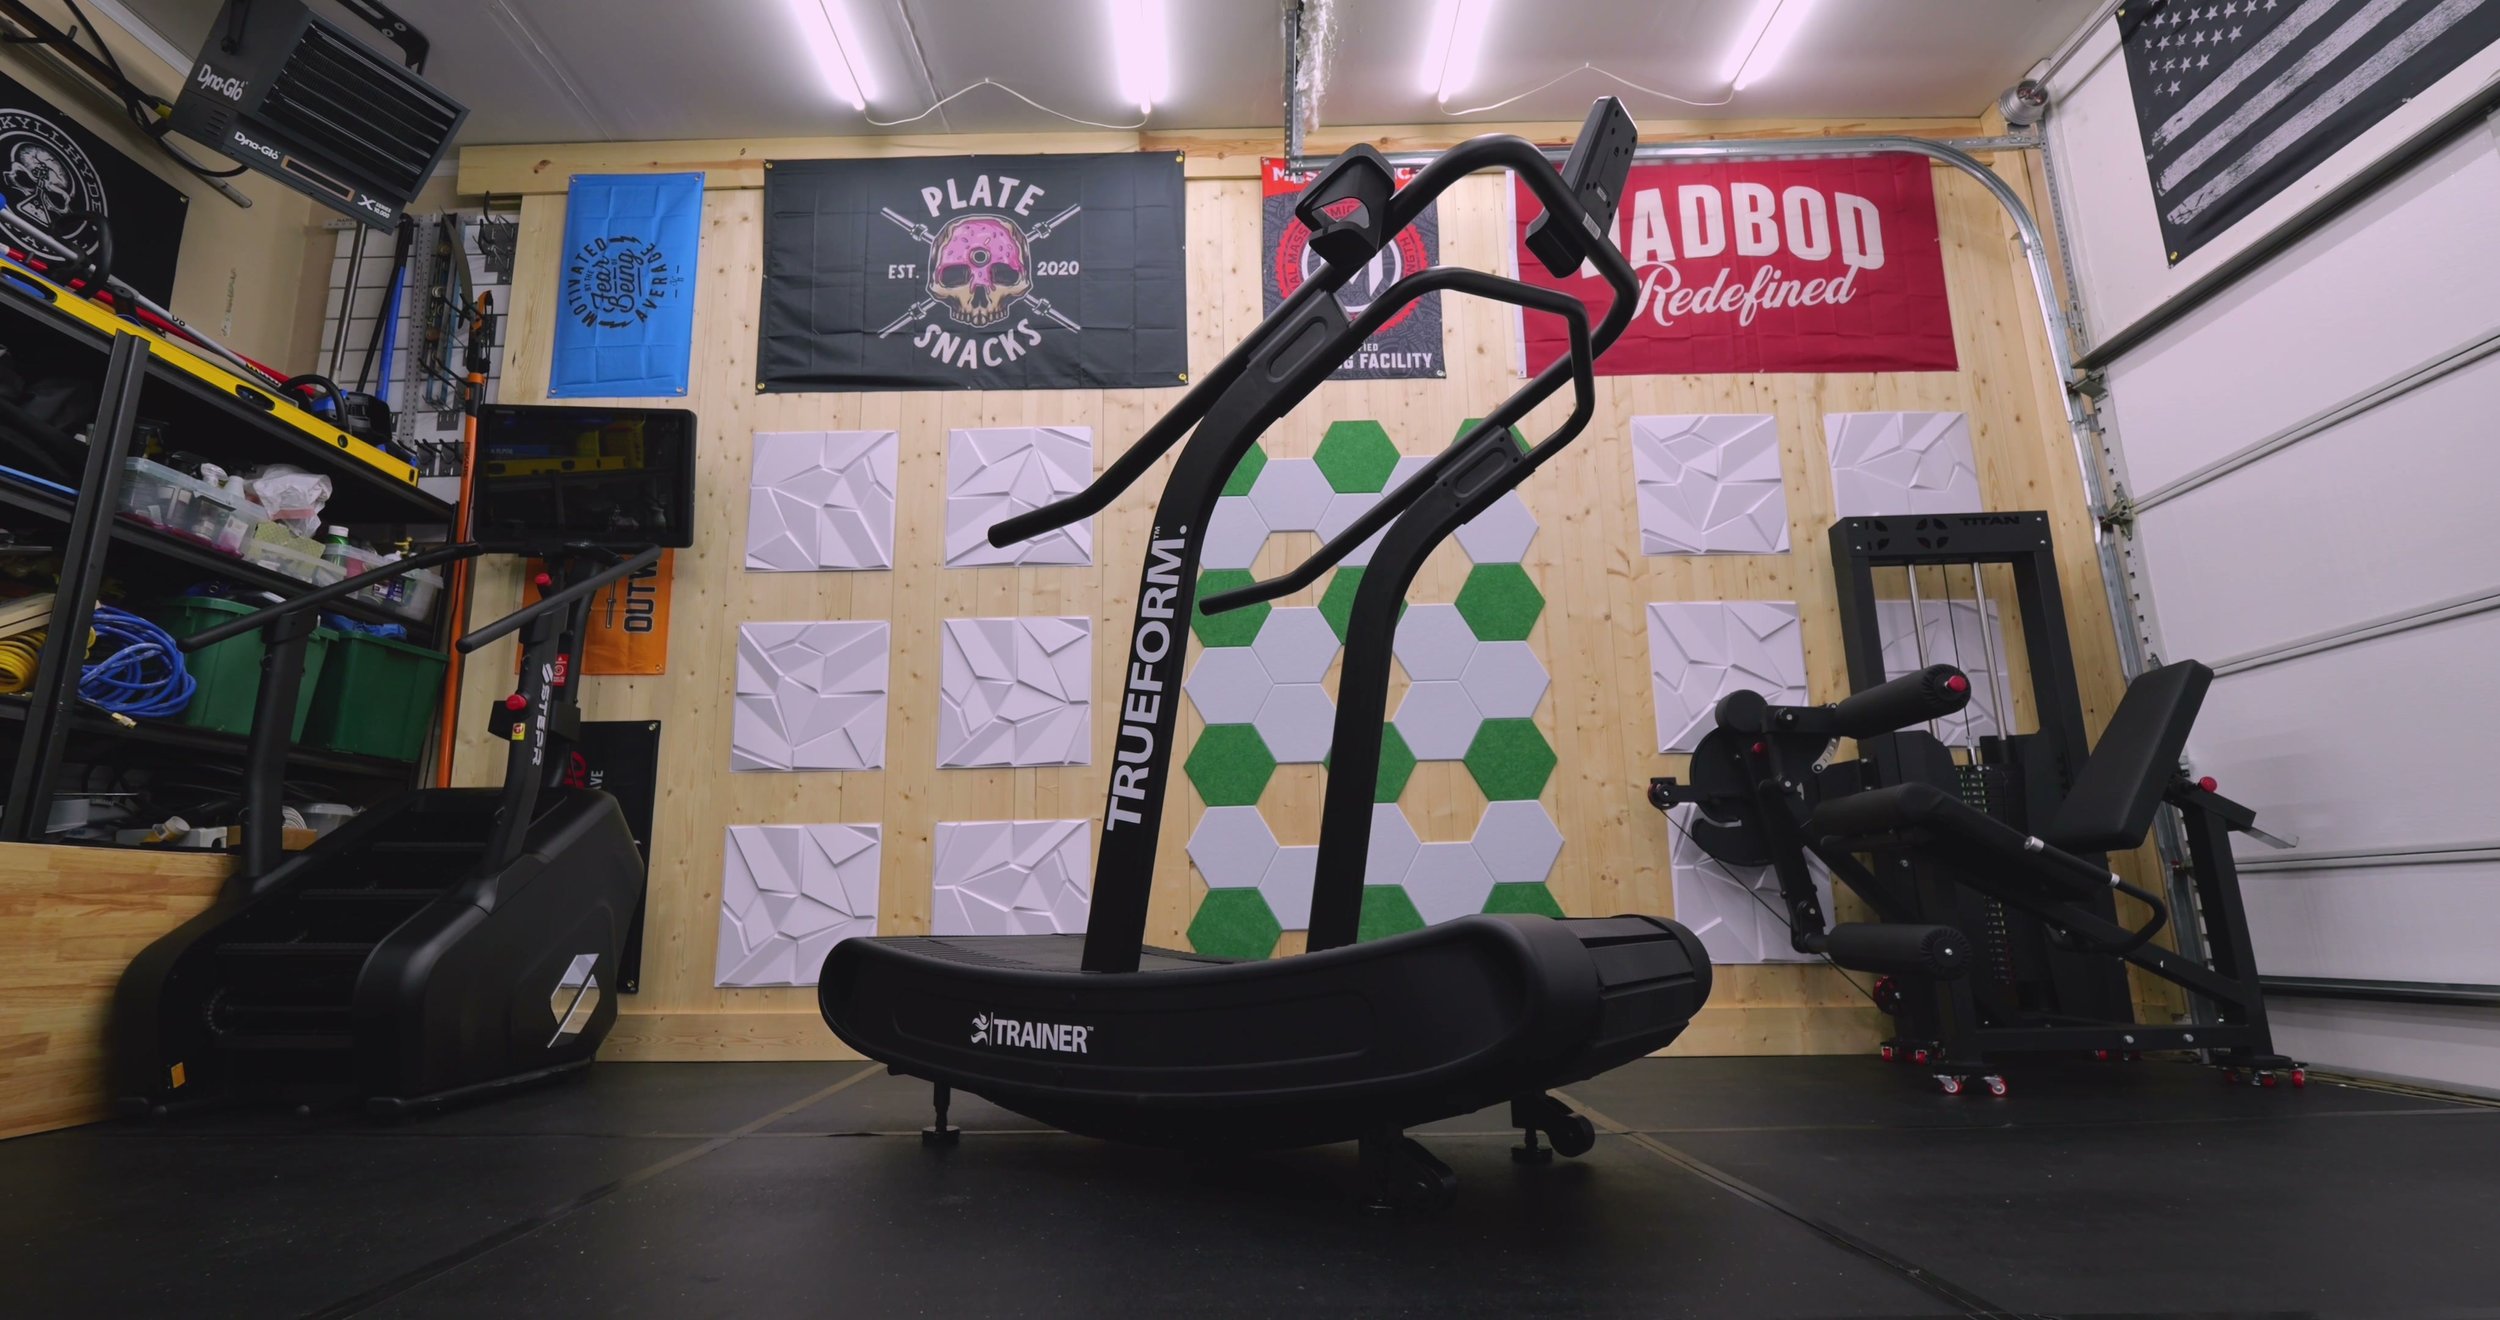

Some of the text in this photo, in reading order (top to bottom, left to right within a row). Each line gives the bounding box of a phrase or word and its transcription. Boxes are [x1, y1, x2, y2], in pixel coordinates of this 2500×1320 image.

[920, 174, 1045, 218] PLATE
[1582, 182, 1885, 279] ADBOD
[568, 237, 608, 328] MOTIVATED
[591, 255, 613, 309] Fear
[603, 248, 644, 313] Being
[635, 242, 668, 323] AVERAGE
[888, 261, 1080, 280] EST. 2020
[1632, 261, 1856, 327] Redefined
[914, 318, 1042, 370] SNACKS
[1359, 353, 1432, 369] FACILITY
[1959, 515, 2020, 526] TITAN
